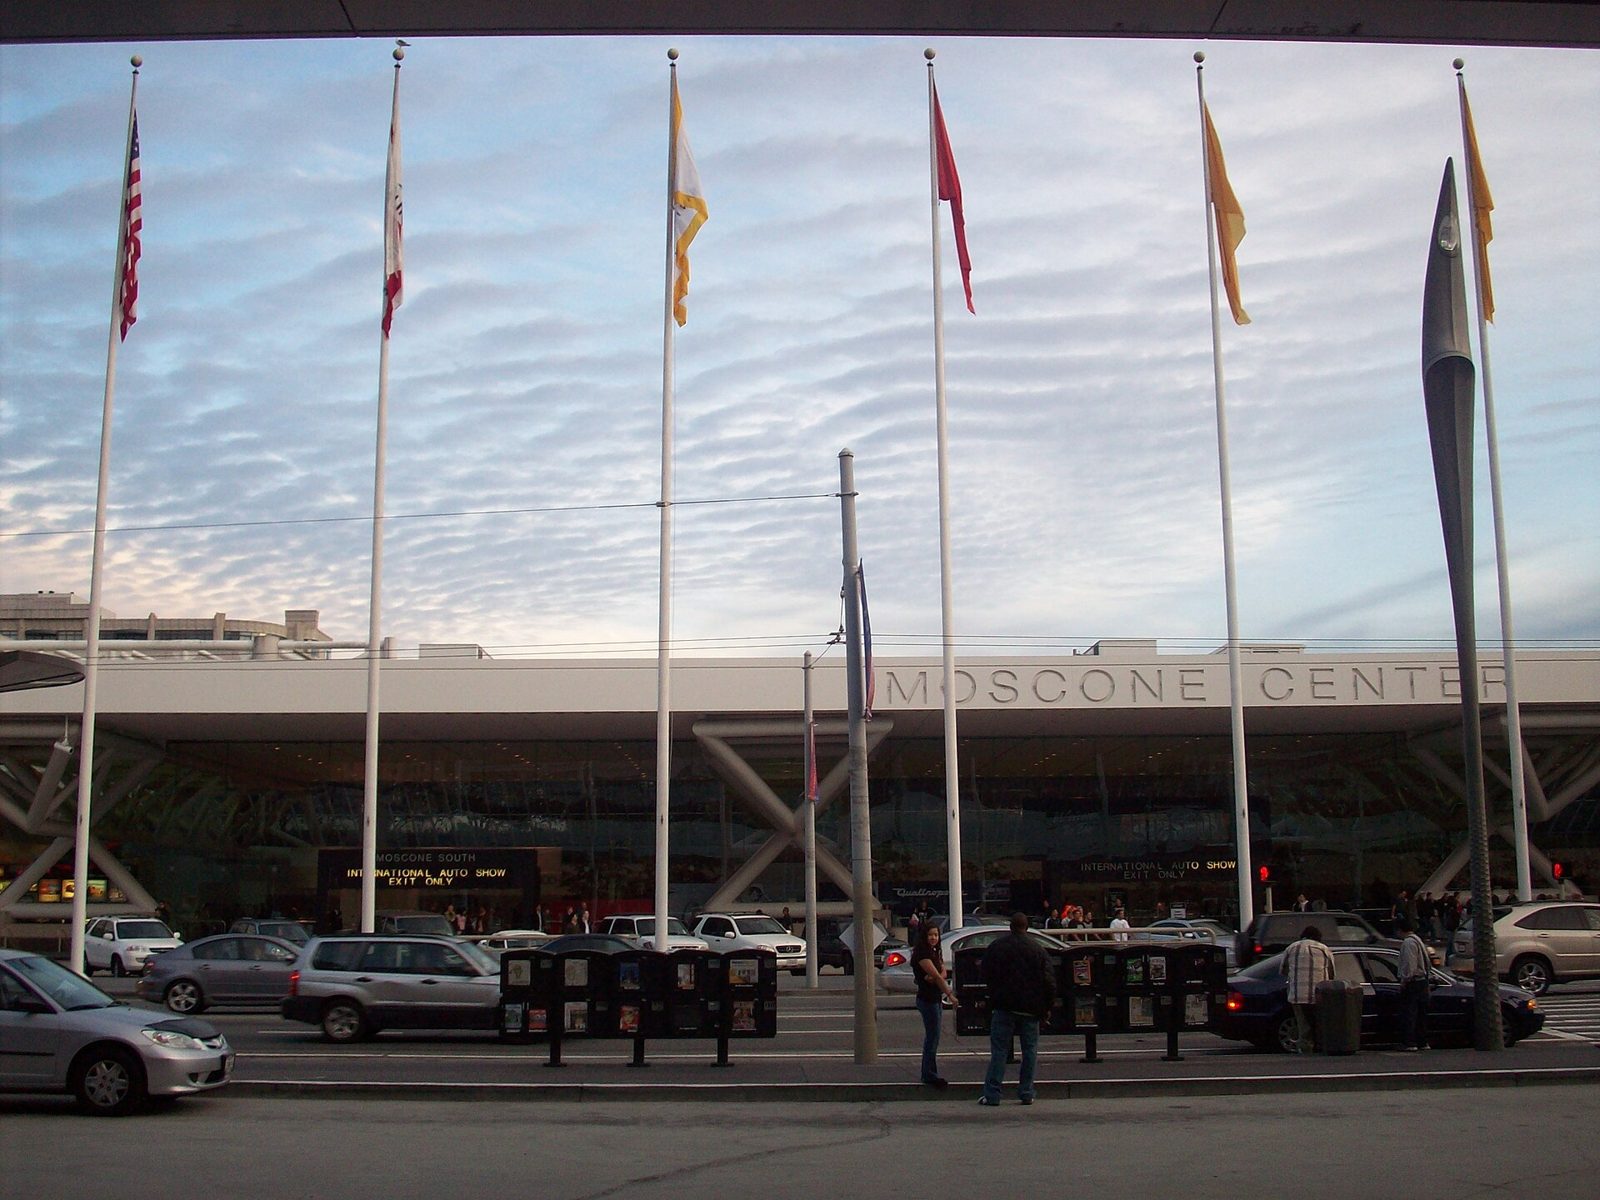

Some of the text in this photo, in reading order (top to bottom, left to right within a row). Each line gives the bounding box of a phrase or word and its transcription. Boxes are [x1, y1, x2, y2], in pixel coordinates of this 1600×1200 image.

[886, 665, 1508, 704] MOSCONE CENTER
[376, 852, 476, 862] MOSCONE SOUTH
[1080, 861, 1236, 872] INTERNATIONAL AUTO SHOW
[347, 869, 506, 877] INTNATIONAL AUTO SHOW
[1124, 871, 1150, 879] EXIT
[389, 878, 453, 886] EXIT ONLY
